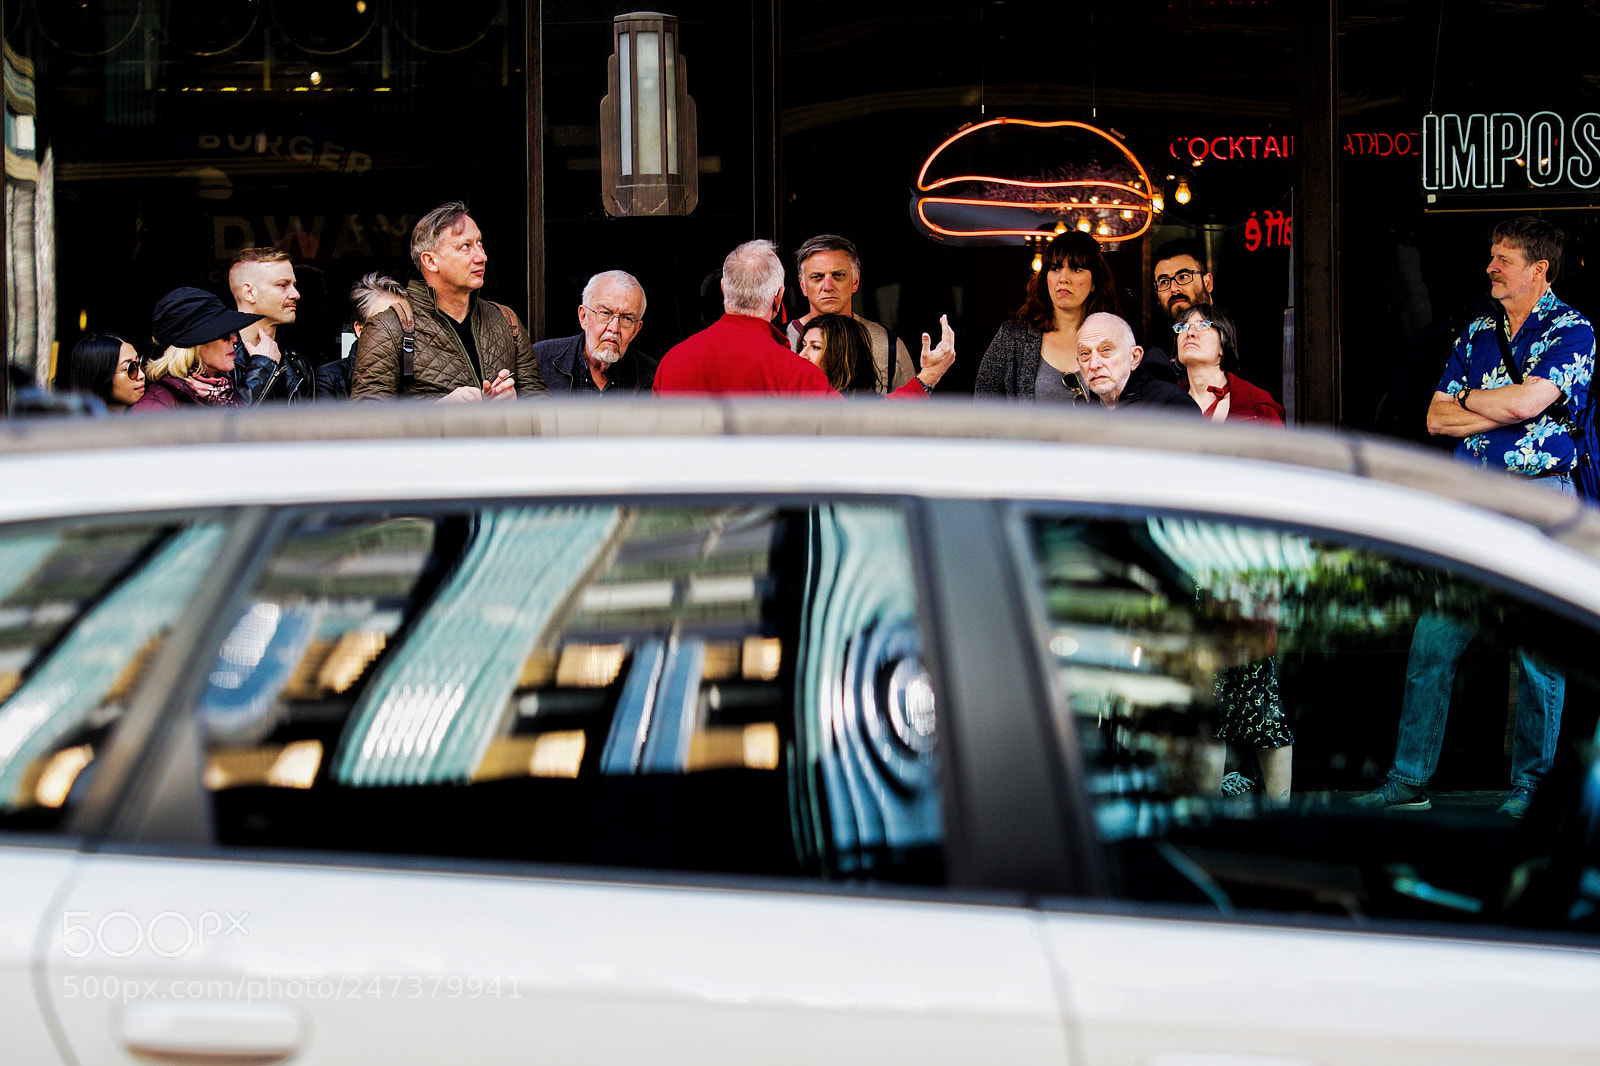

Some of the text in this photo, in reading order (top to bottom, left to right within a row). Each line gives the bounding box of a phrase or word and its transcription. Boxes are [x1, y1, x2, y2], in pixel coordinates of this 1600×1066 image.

[196, 132, 374, 178] BURGER
[1169, 135, 1294, 161] COCKTAI
[1421, 111, 1600, 190] IMPOS
